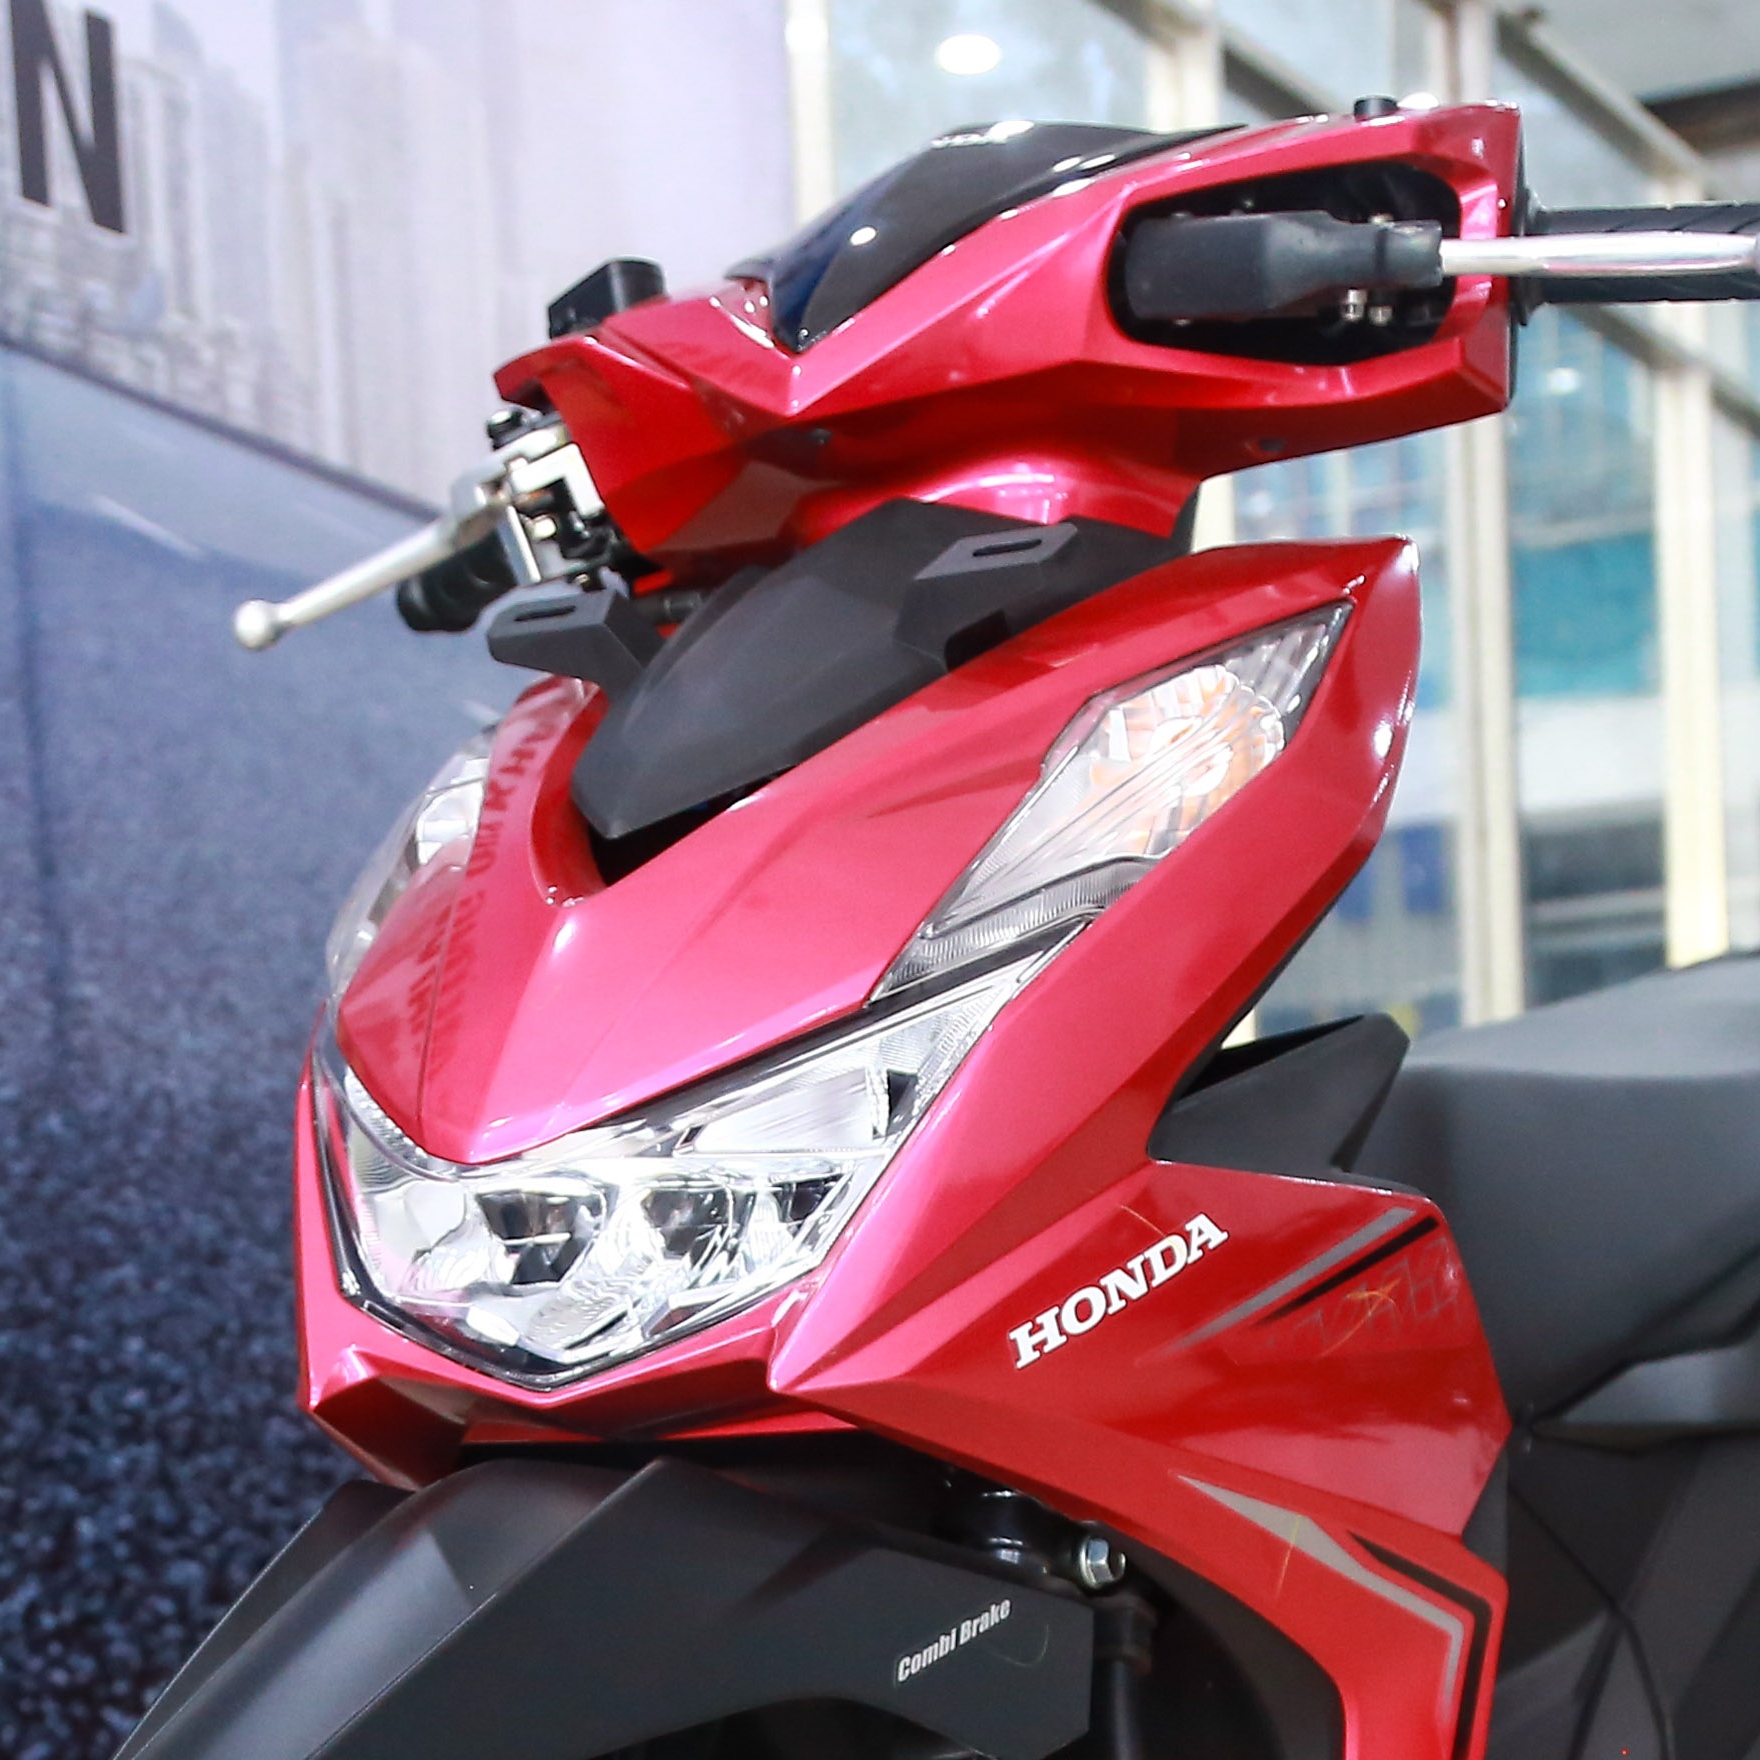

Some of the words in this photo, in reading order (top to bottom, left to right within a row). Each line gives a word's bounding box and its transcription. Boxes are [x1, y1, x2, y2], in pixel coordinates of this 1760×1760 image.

[1009, 1213, 1229, 1369] HONDA
[898, 1628, 957, 1682] Combi
[959, 1599, 1011, 1645] Brake
